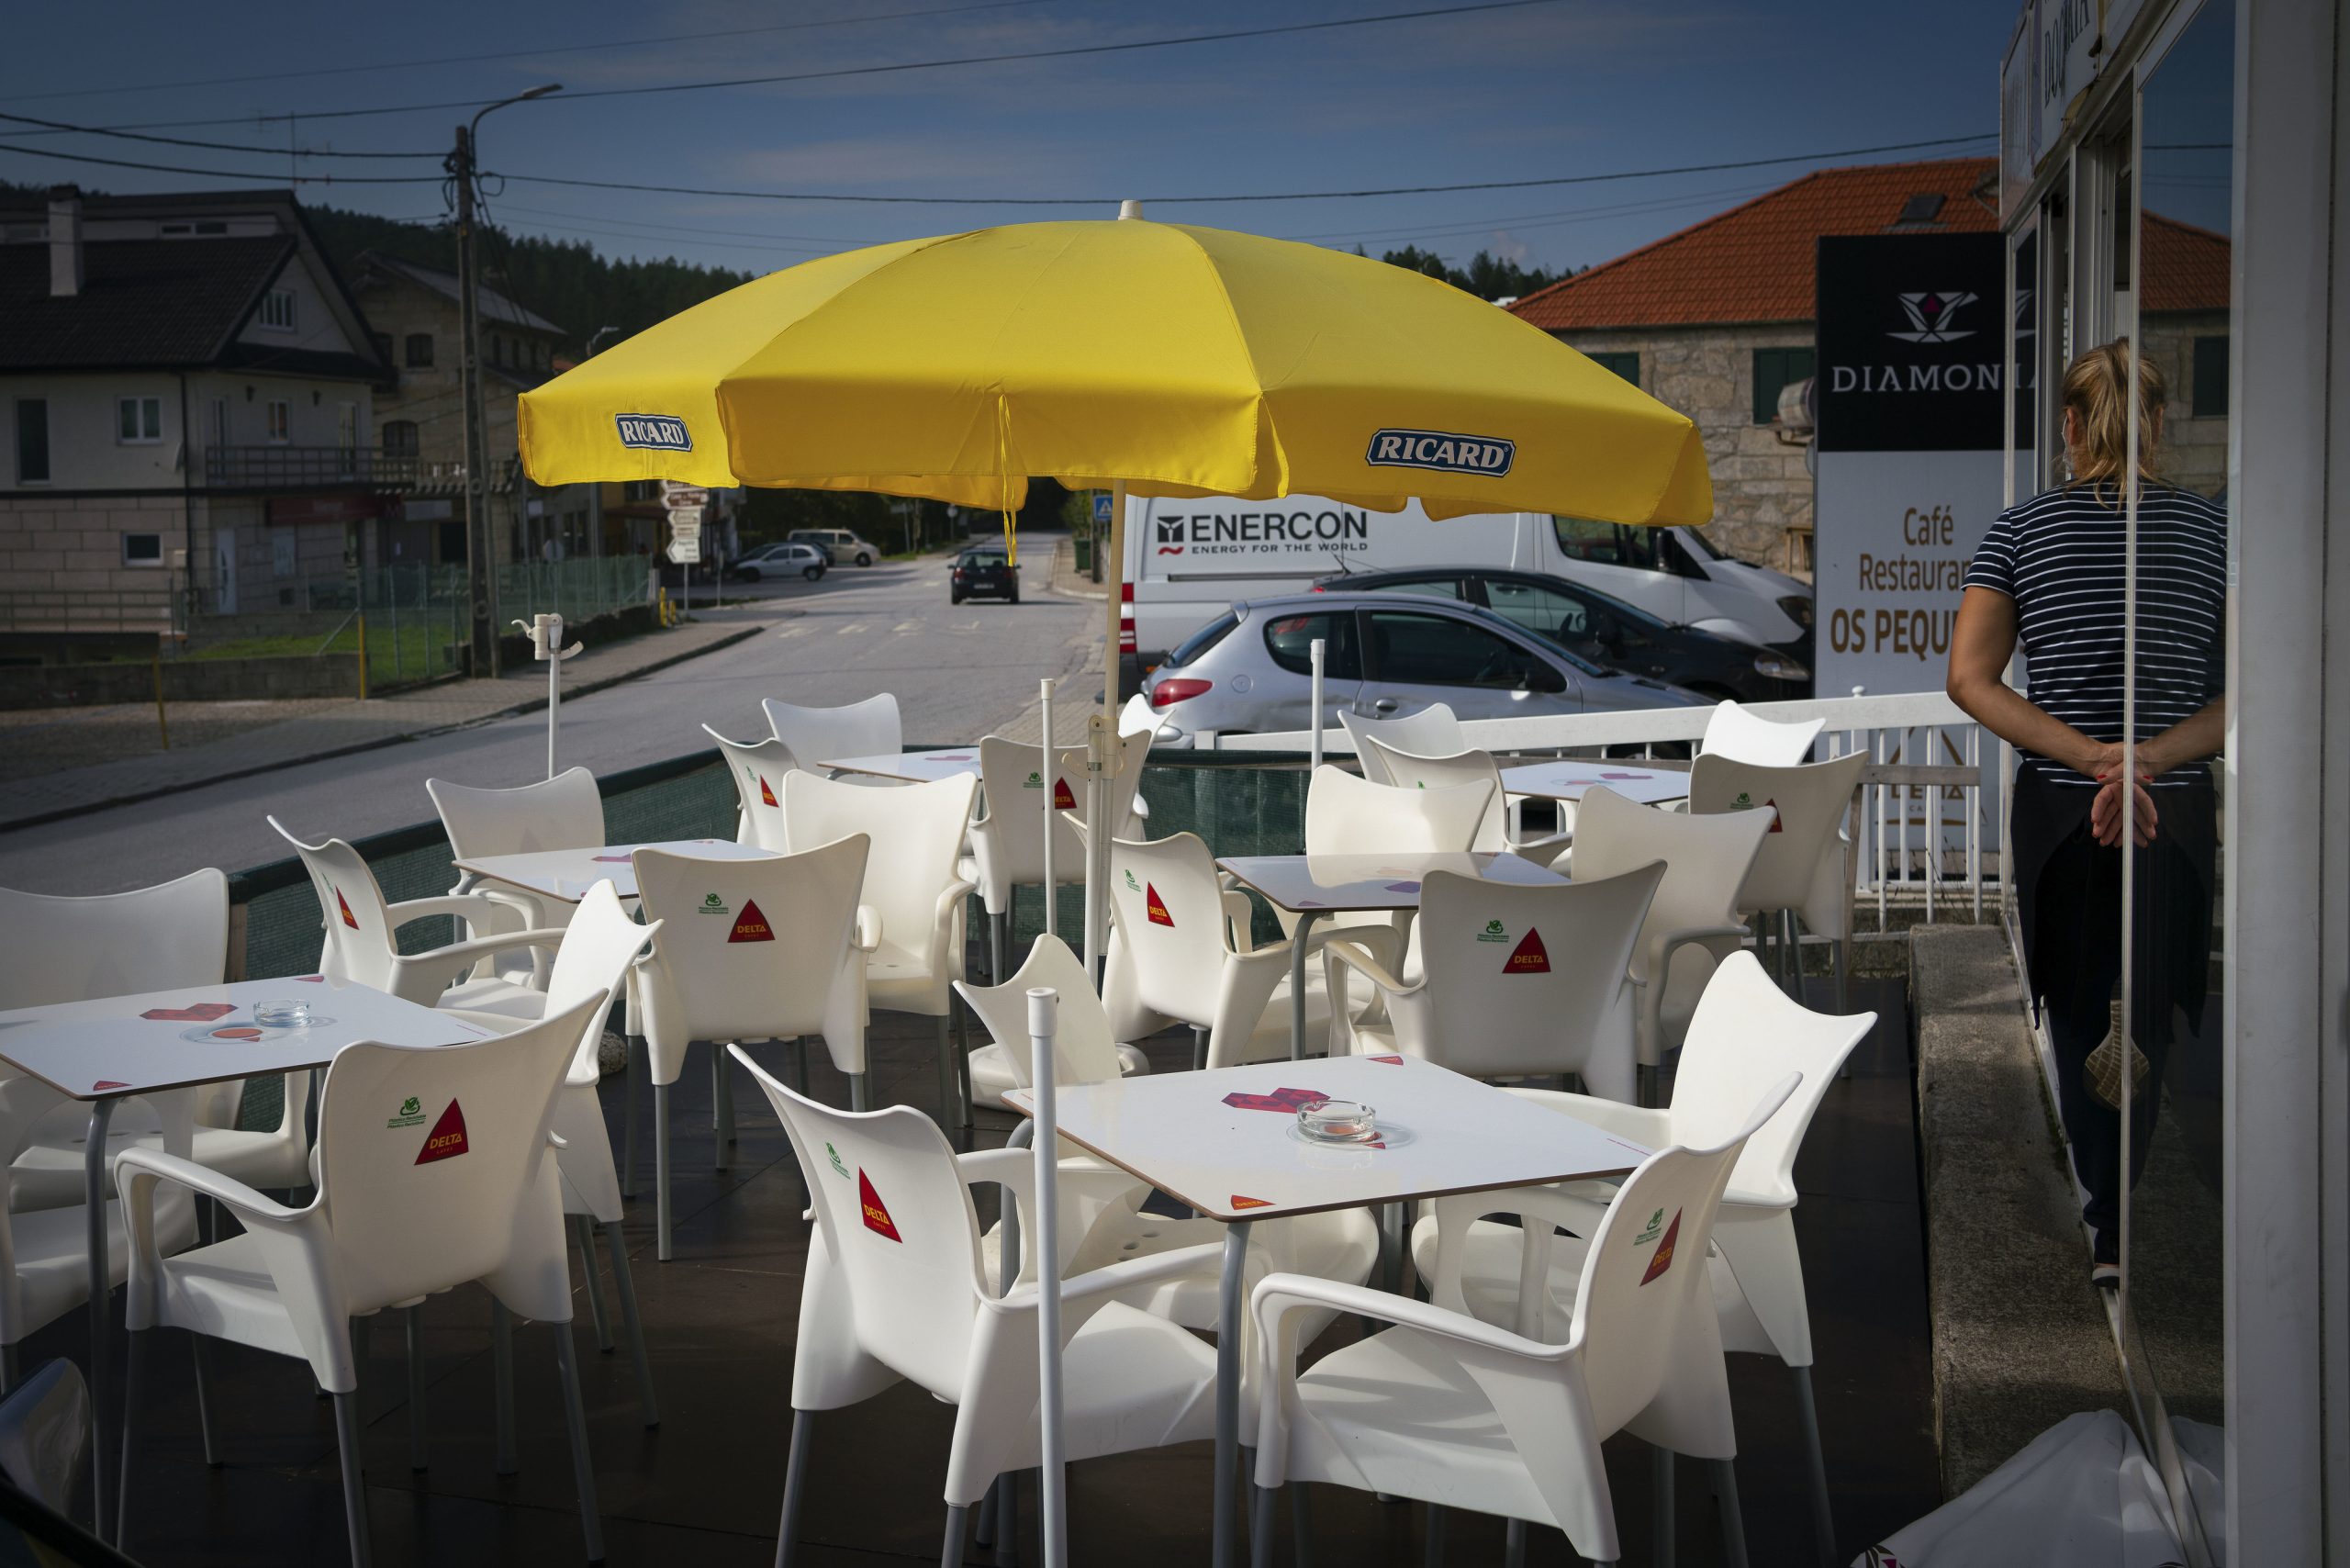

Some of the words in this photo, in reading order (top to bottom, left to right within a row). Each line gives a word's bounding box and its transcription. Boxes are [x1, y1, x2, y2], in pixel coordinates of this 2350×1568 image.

[1831, 364, 2002, 392] DIAMON
[620, 420, 685, 444] RICARD
[1377, 436, 1505, 468] RICARD
[1191, 510, 1368, 542] ENERCON
[1903, 505, 1954, 546] Café
[1192, 544, 1247, 554] ENERGY
[1252, 543, 1279, 553] FOR
[1285, 543, 1313, 553] THE
[1317, 542, 1368, 552] WORLD
[1859, 553, 1971, 592] Restauran
[1830, 608, 1866, 655] OS
[737, 924, 767, 934] DELTA
[1514, 955, 1544, 964] DELTA
[430, 1133, 463, 1149] DELTA
[863, 1204, 890, 1226] DELTA
